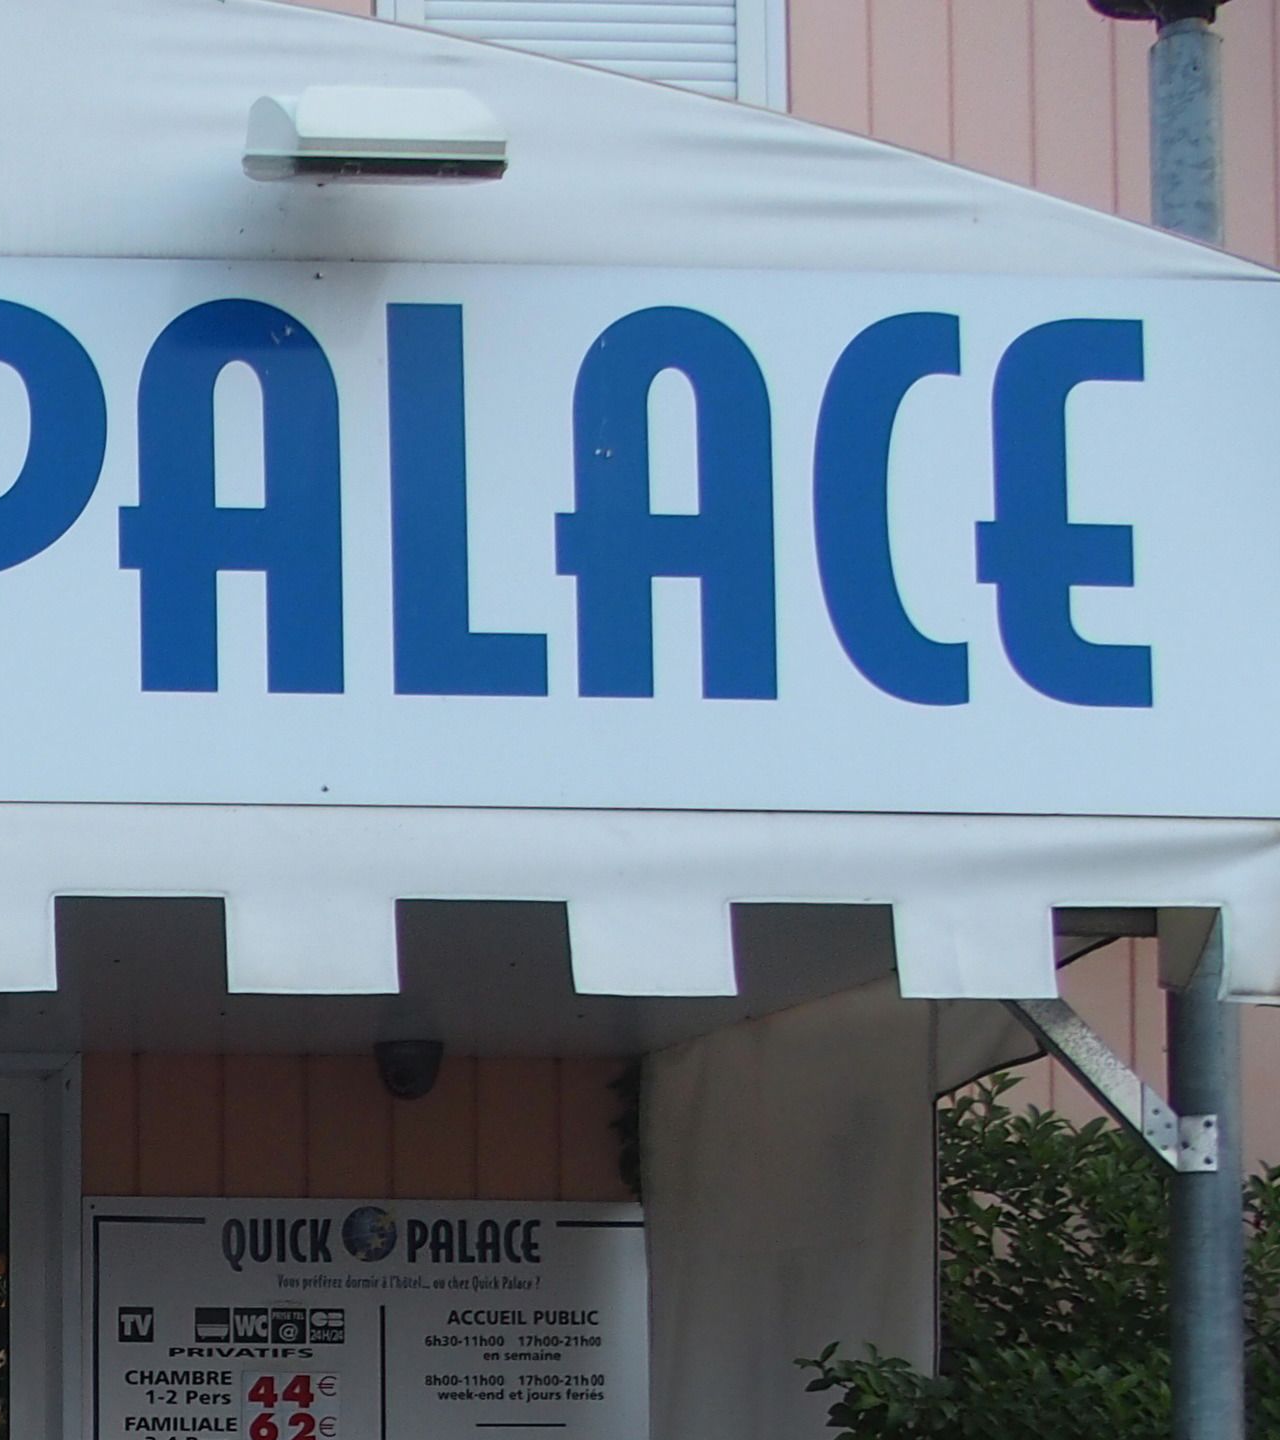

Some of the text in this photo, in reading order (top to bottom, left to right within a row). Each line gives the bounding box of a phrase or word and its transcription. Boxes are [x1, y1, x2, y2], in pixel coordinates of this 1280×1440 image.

[222, 1218, 541, 1273] QUICK PALACE
[277, 1274, 299, 1288] Vous
[345, 1274, 378, 1288] dormir
[433, 1278, 445, 1289] ou
[448, 1275, 470, 1289] chez
[471, 1275, 499, 1292] Quick
[502, 1275, 532, 1289] Palace
[535, 1275, 541, 1289] ?
[121, 1314, 152, 1336] TV
[447, 1310, 599, 1325] ACCUEIL PUBLIC
[234, 1315, 267, 1337] WC
[310, 1329, 344, 1341] 24H/24
[424, 1335, 602, 1347] 6h30-11h00 17h00-21h00
[168, 1347, 314, 1359] PRIVATIFS
[483, 1349, 562, 1361] en semaine
[124, 1370, 233, 1385] CHAMBRE
[424, 1374, 605, 1386] 8h00-11h00 17h00-21h00
[145, 1390, 232, 1405] 1-2 Pers
[437, 1388, 504, 1401] week-end
[508, 1390, 523, 1401] et
[526, 1388, 561, 1403] jours
[124, 1416, 238, 1432] FAMILIALE
